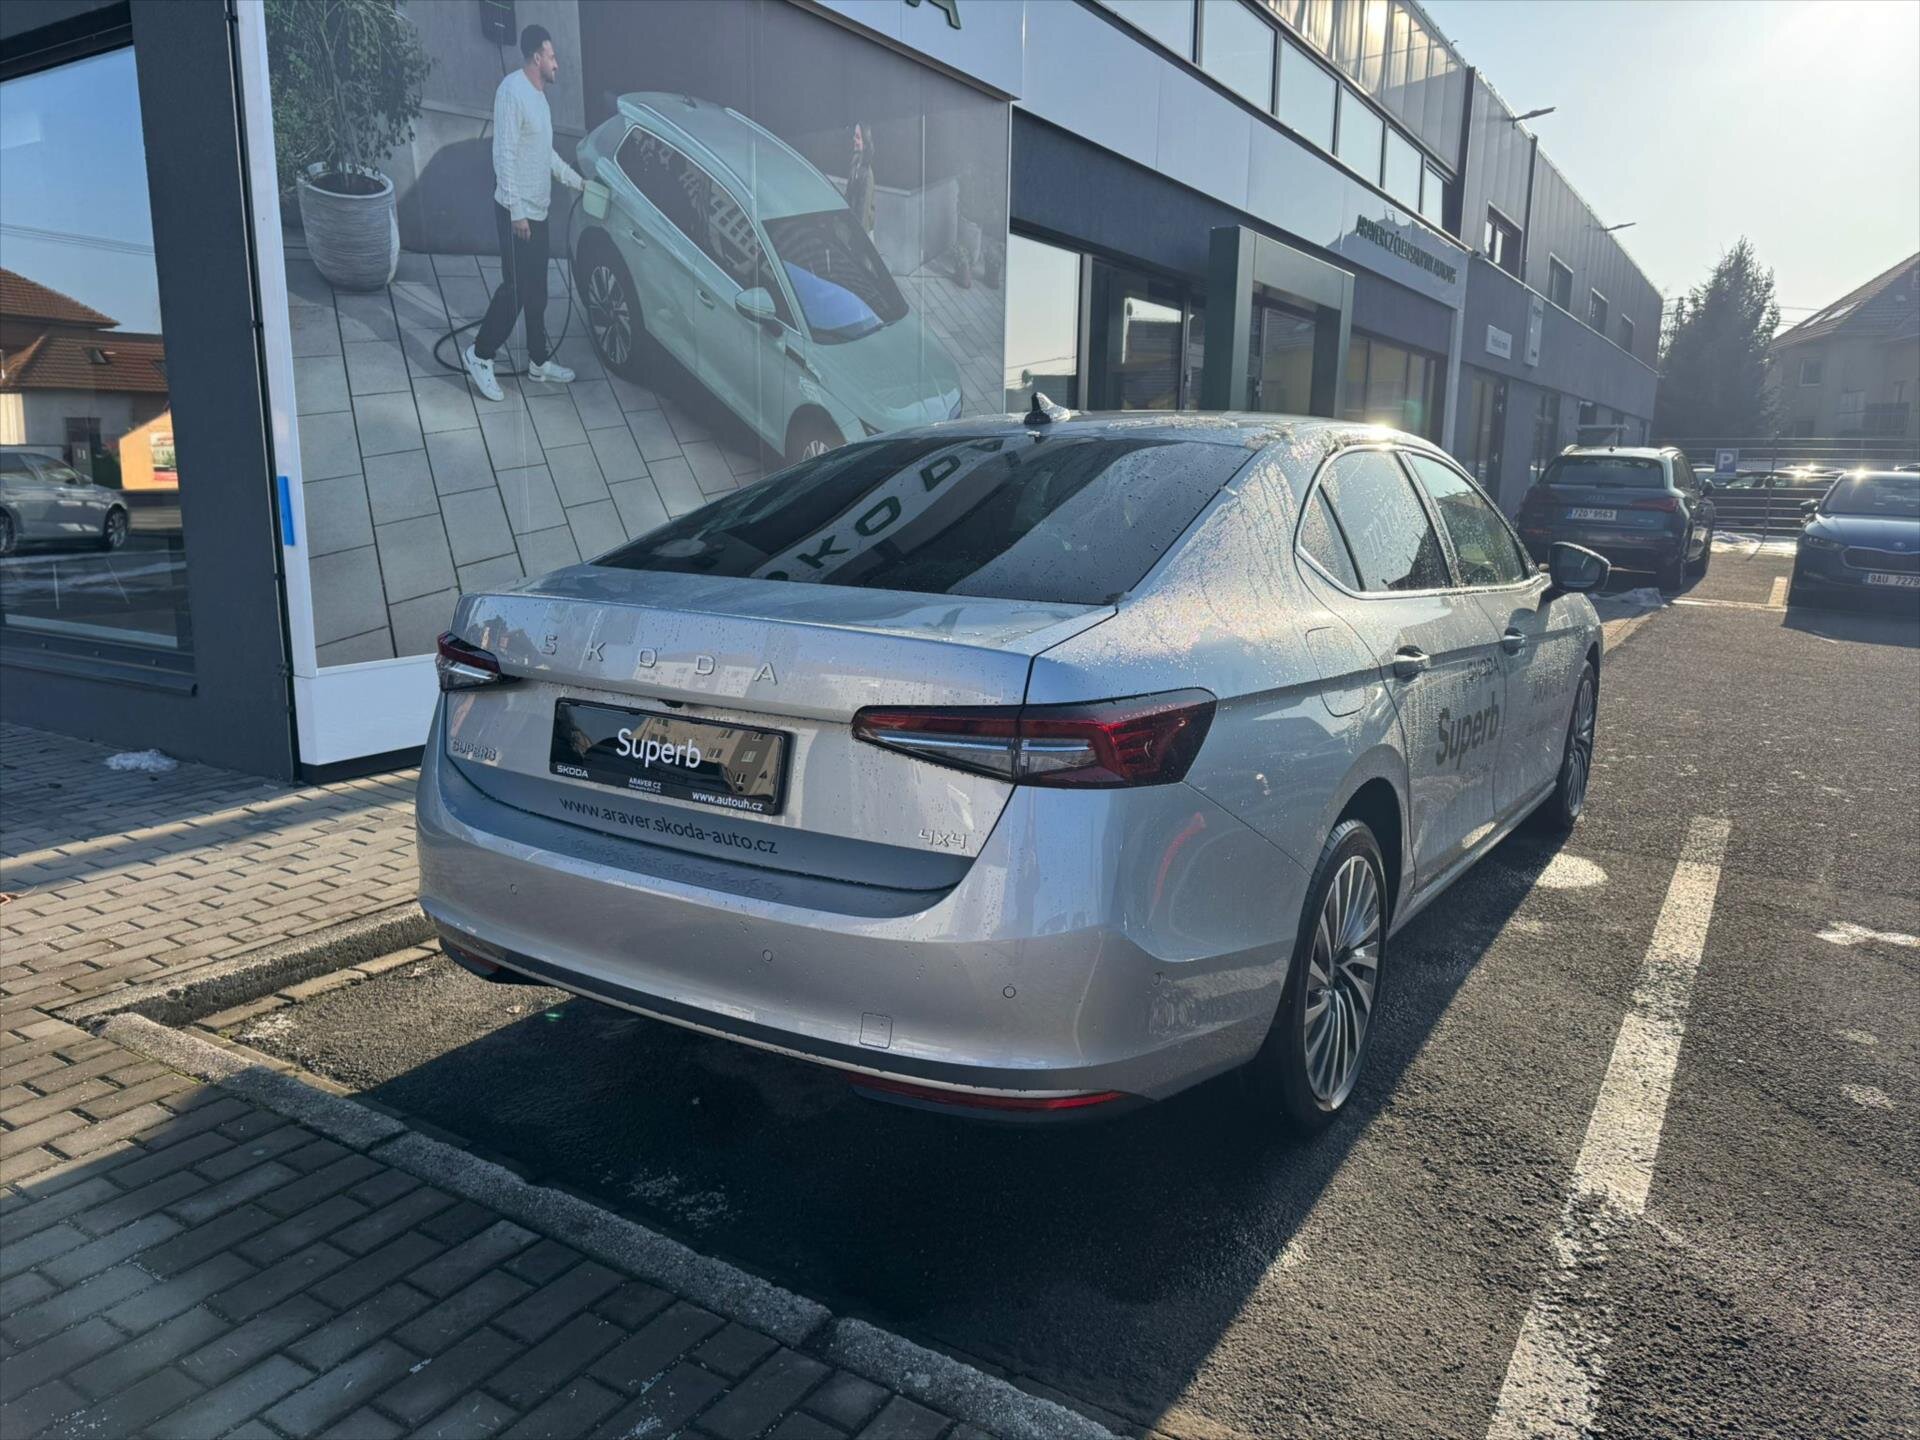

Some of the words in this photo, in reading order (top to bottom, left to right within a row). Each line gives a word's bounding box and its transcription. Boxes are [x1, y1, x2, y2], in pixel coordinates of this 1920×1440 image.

[1719, 453, 1733, 470] P
[1435, 691, 1500, 770] Superb
[616, 727, 701, 768] Superb
[628, 776, 652, 787] ARAVER
[652, 780, 662, 789] CZ
[692, 791, 763, 811] www.autouh.cz
[559, 798, 778, 854] www.araver.skoda-auto.cz
[918, 829, 967, 849] 4x4
